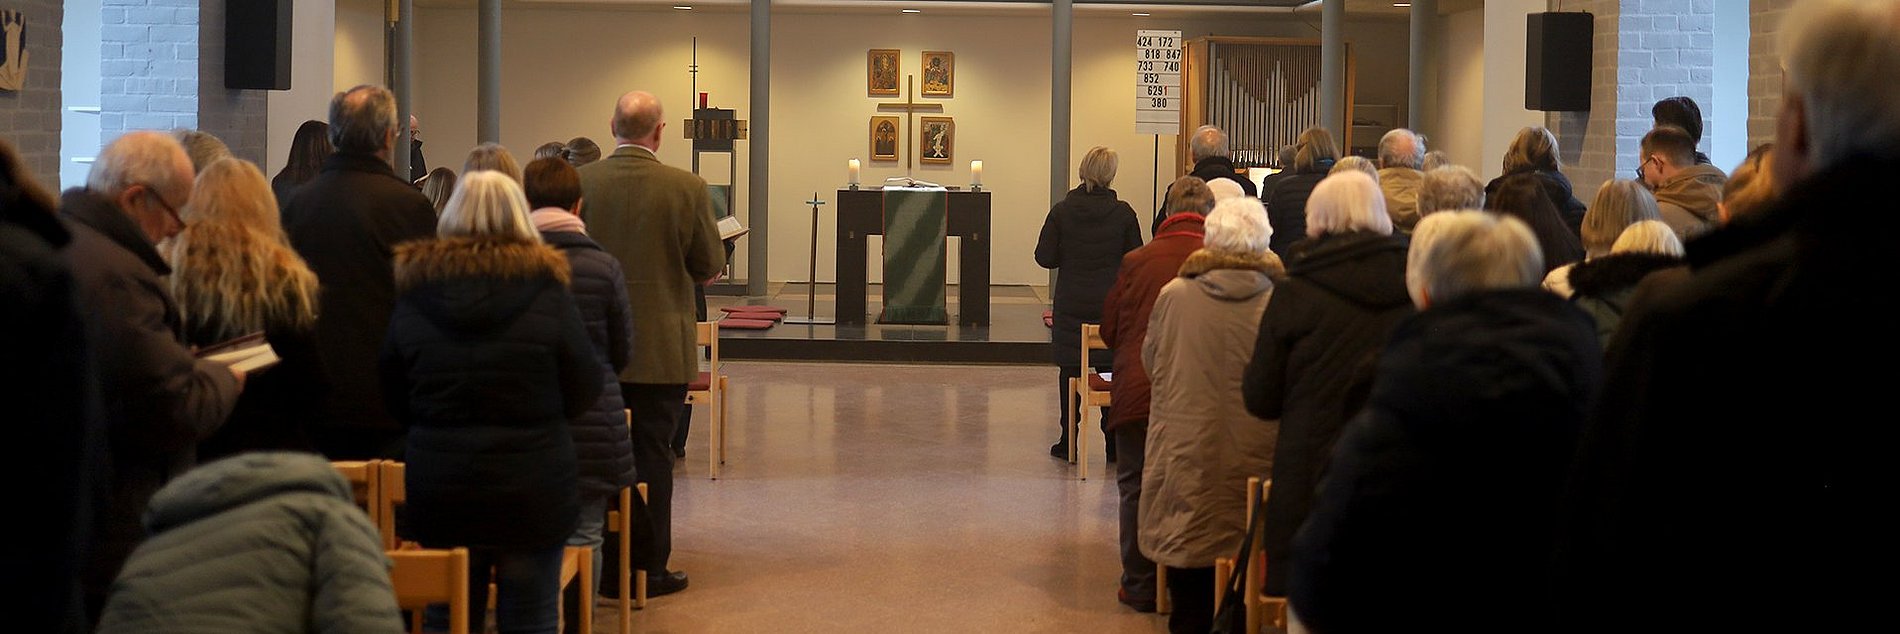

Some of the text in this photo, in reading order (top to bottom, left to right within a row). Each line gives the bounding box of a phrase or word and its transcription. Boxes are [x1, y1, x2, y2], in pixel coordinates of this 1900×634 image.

[1137, 37, 1173, 47] 424 172
[1145, 49, 1181, 59] 818 847
[1138, 61, 1179, 72] 733 740
[1144, 73, 1159, 83] 852
[1151, 97, 1167, 108] 380
